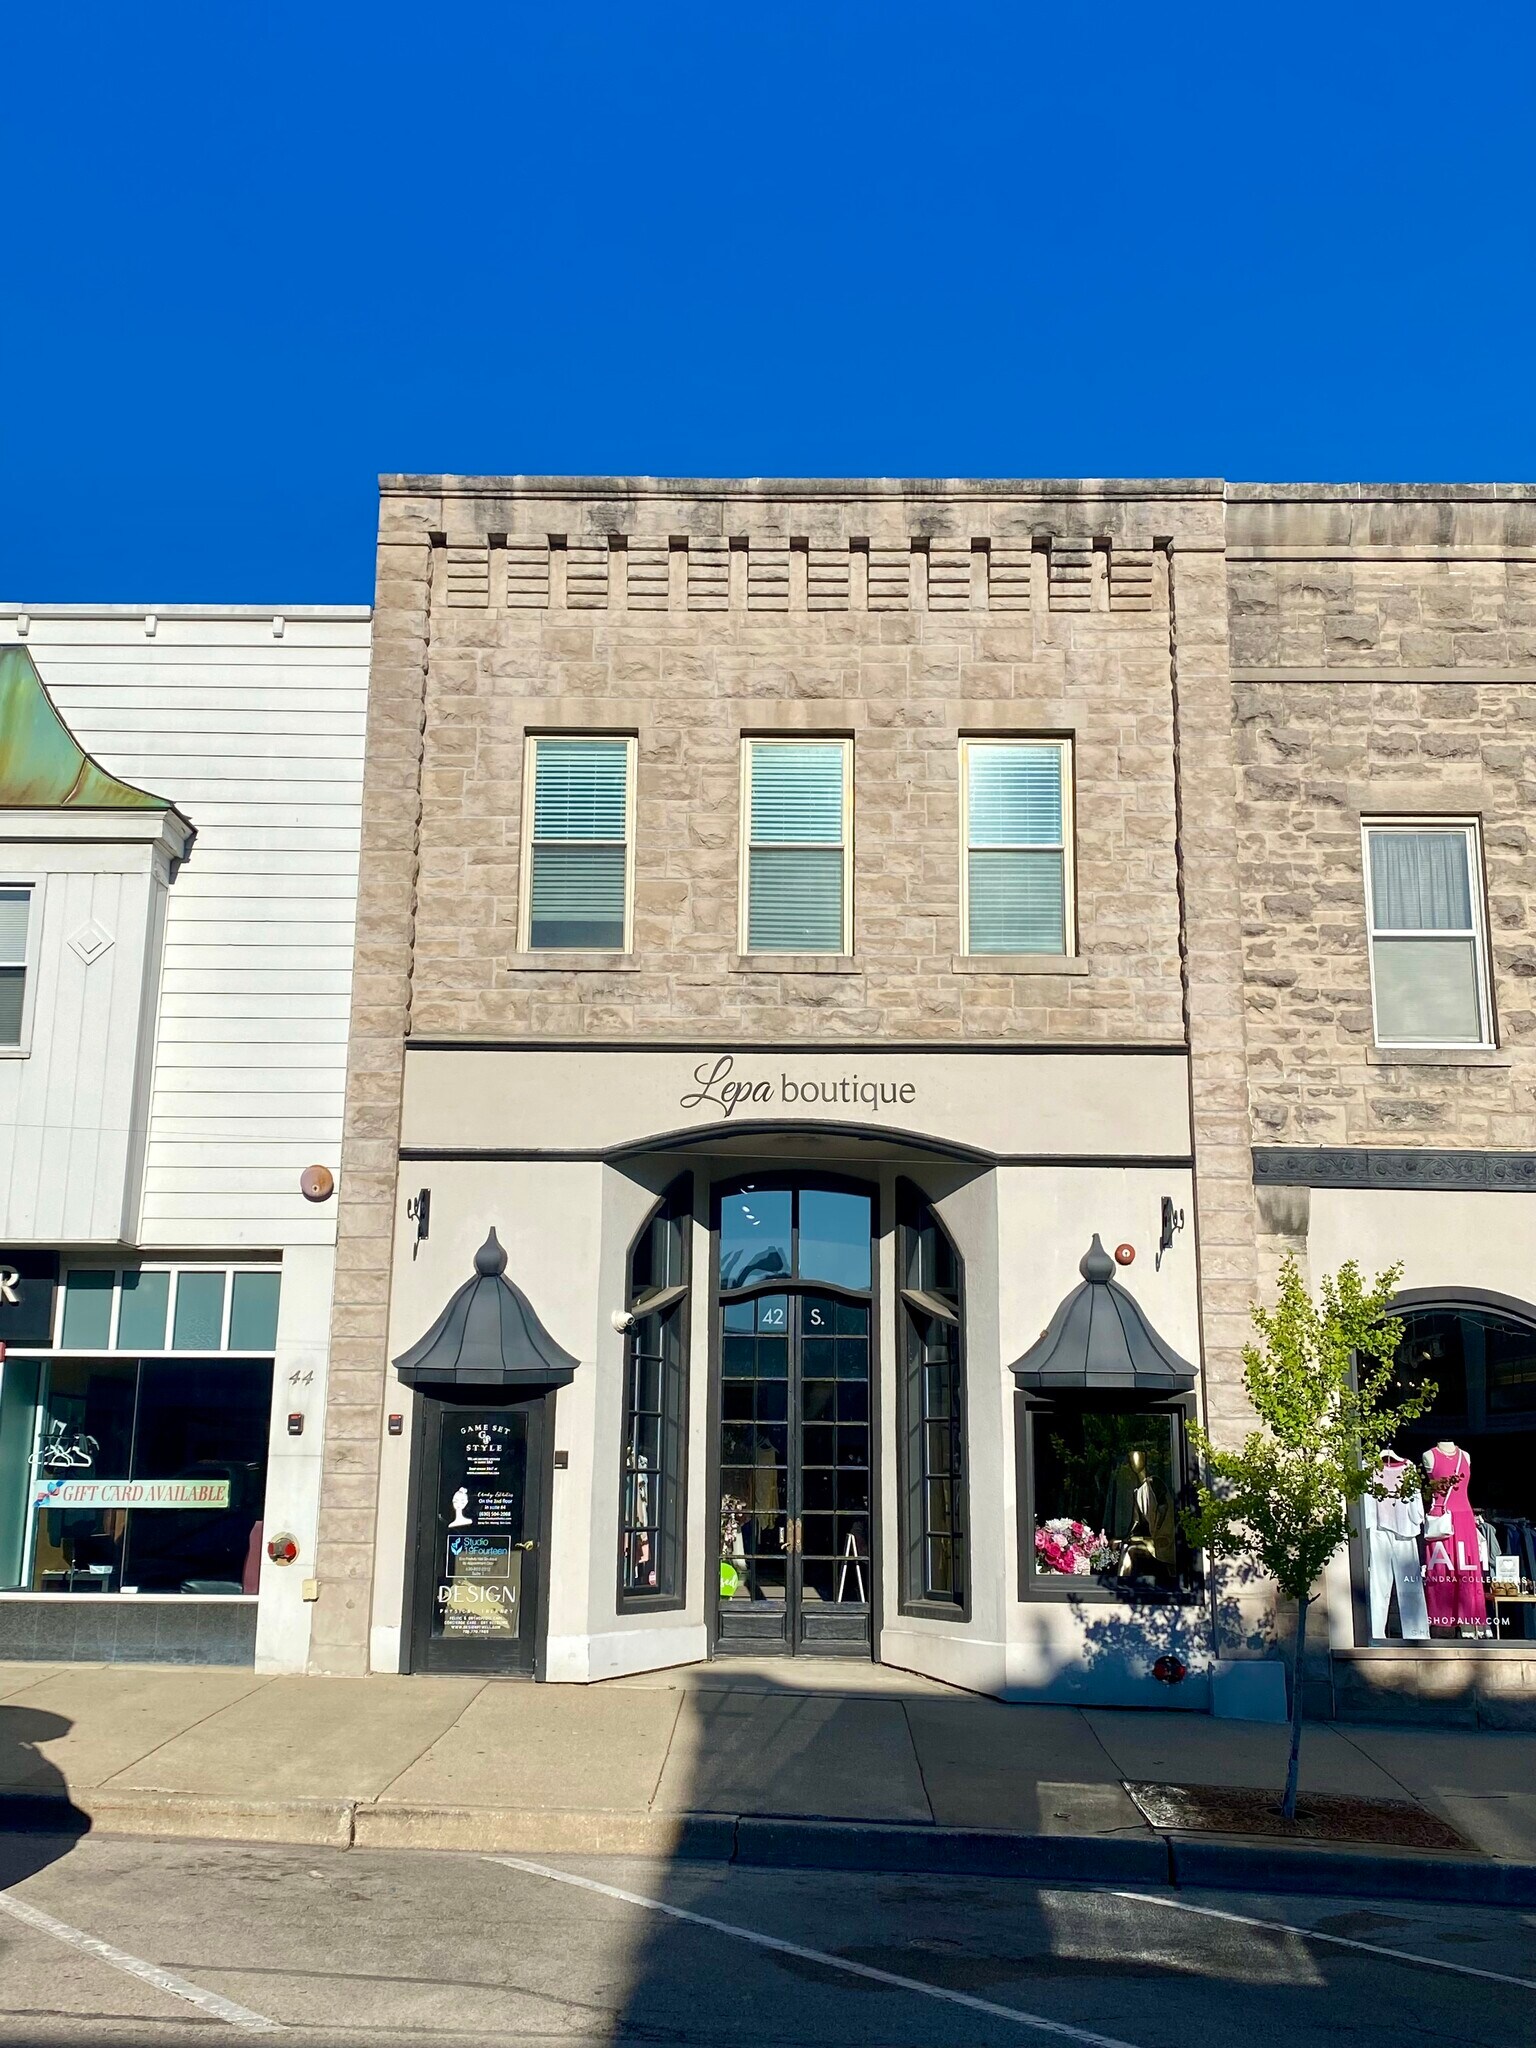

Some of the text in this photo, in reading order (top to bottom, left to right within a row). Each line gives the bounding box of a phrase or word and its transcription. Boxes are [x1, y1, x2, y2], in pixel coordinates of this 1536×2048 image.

[680, 1055, 916, 1118] Lepa boutique
[762, 1308, 825, 1325] 42 S.
[289, 1370, 314, 1386] 44
[460, 1424, 511, 1435] GAME SET
[466, 1444, 503, 1452] STYLE
[63, 1485, 227, 1501] GIFT CARD AVAILABLE
[463, 1537, 489, 1547] Studio
[1461, 1576, 1527, 1584] COLLECOS
[438, 1585, 516, 1603] DESIGN
[1426, 1616, 1511, 1626] SHOPALIX.COM
